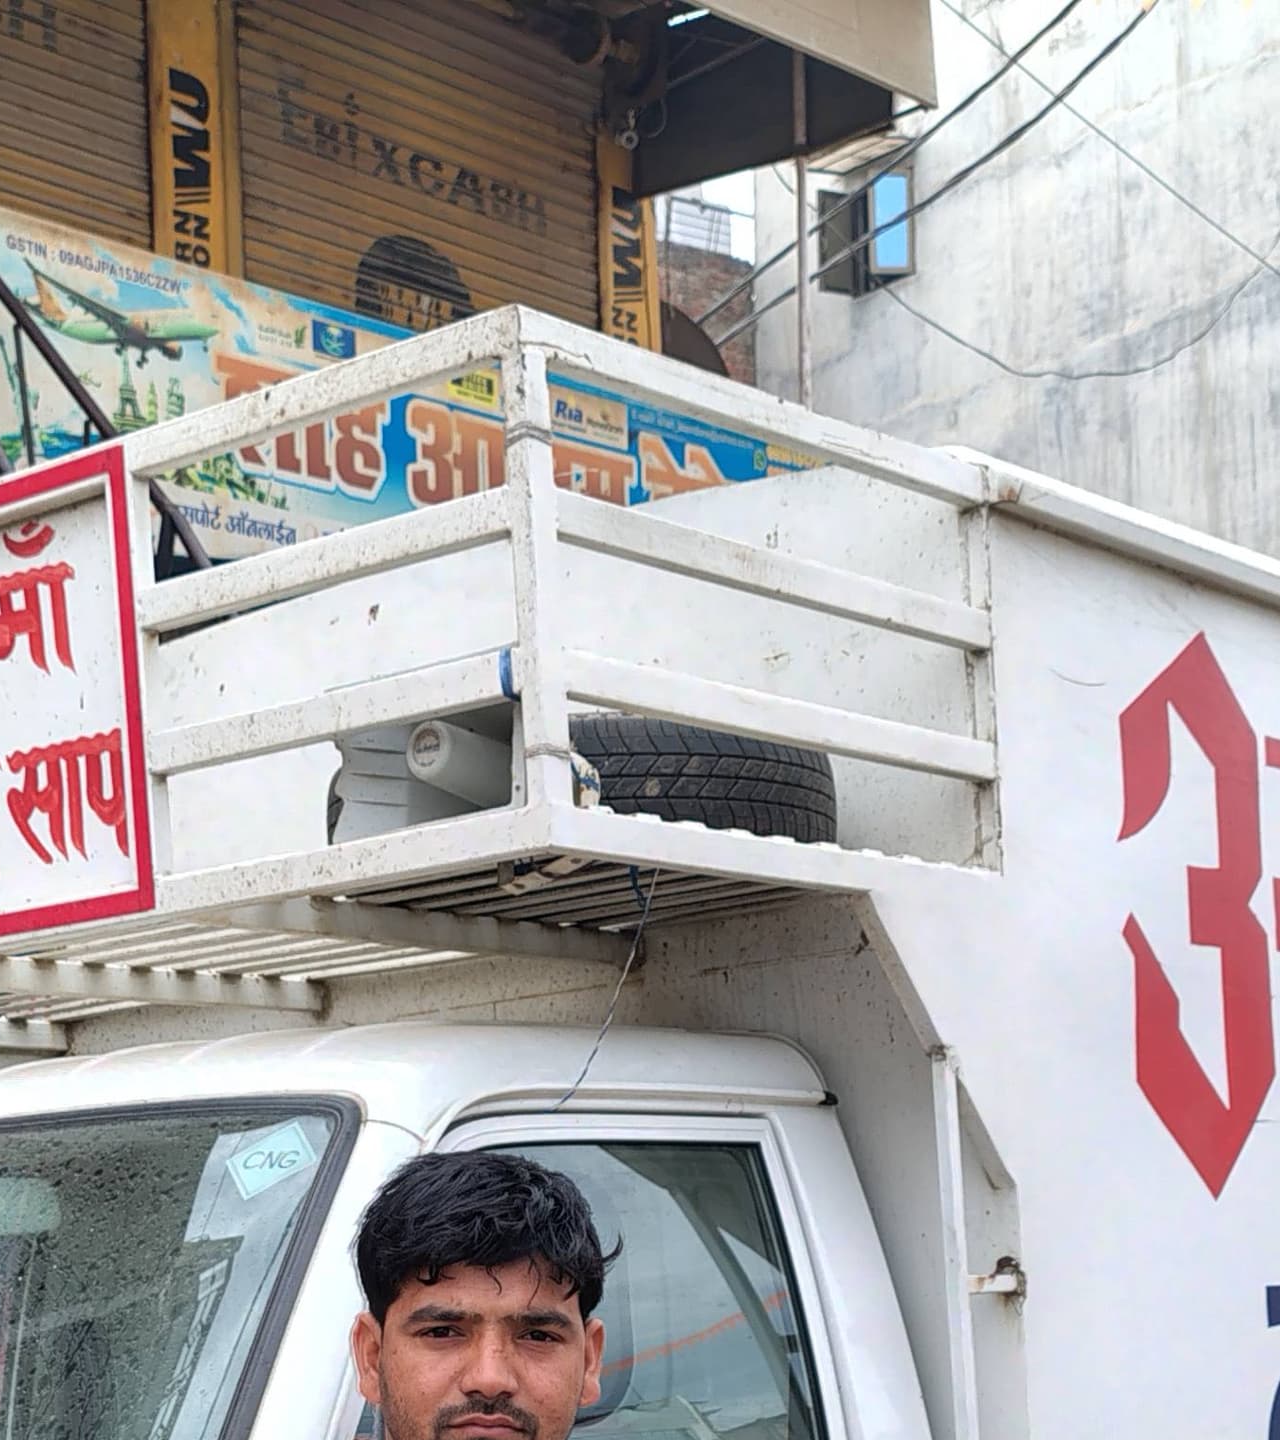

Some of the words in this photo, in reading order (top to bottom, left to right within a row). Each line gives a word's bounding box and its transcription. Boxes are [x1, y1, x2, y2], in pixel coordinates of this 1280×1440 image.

[6, 234, 48, 262] GSTIN
[178, 504, 222, 532] सपोर्ट
[242, 1150, 300, 1170] CNG
